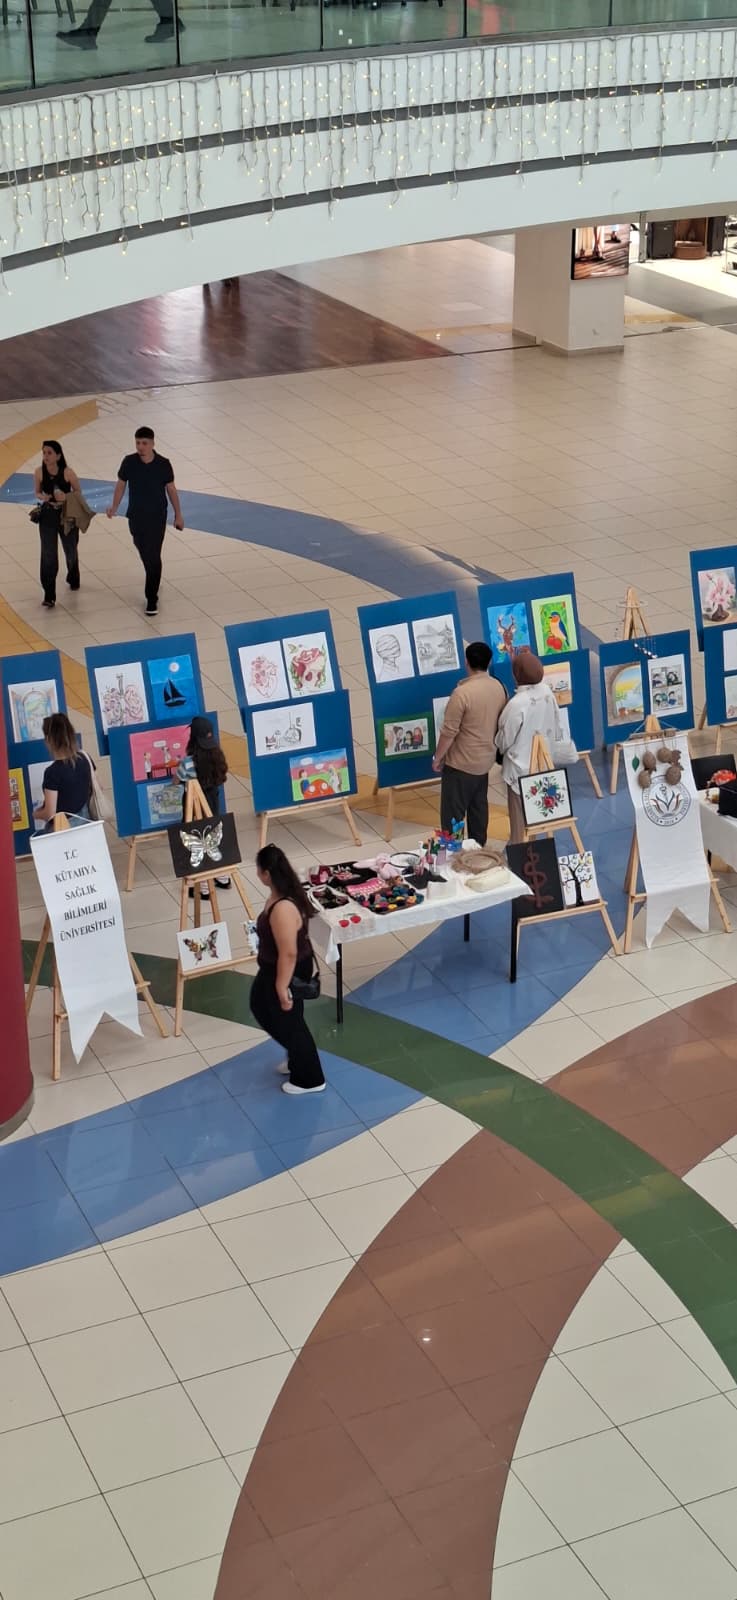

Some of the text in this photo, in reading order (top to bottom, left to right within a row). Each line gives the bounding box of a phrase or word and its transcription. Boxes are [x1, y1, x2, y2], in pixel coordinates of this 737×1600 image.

[64, 849, 78, 860] T.C
[55, 865, 97, 883] KÜTAHYA
[65, 884, 97, 900] SAĞLIK
[64, 899, 107, 920] BİLİMLERİ
[60, 915, 116, 941] ÜNİVERSİTESİ
